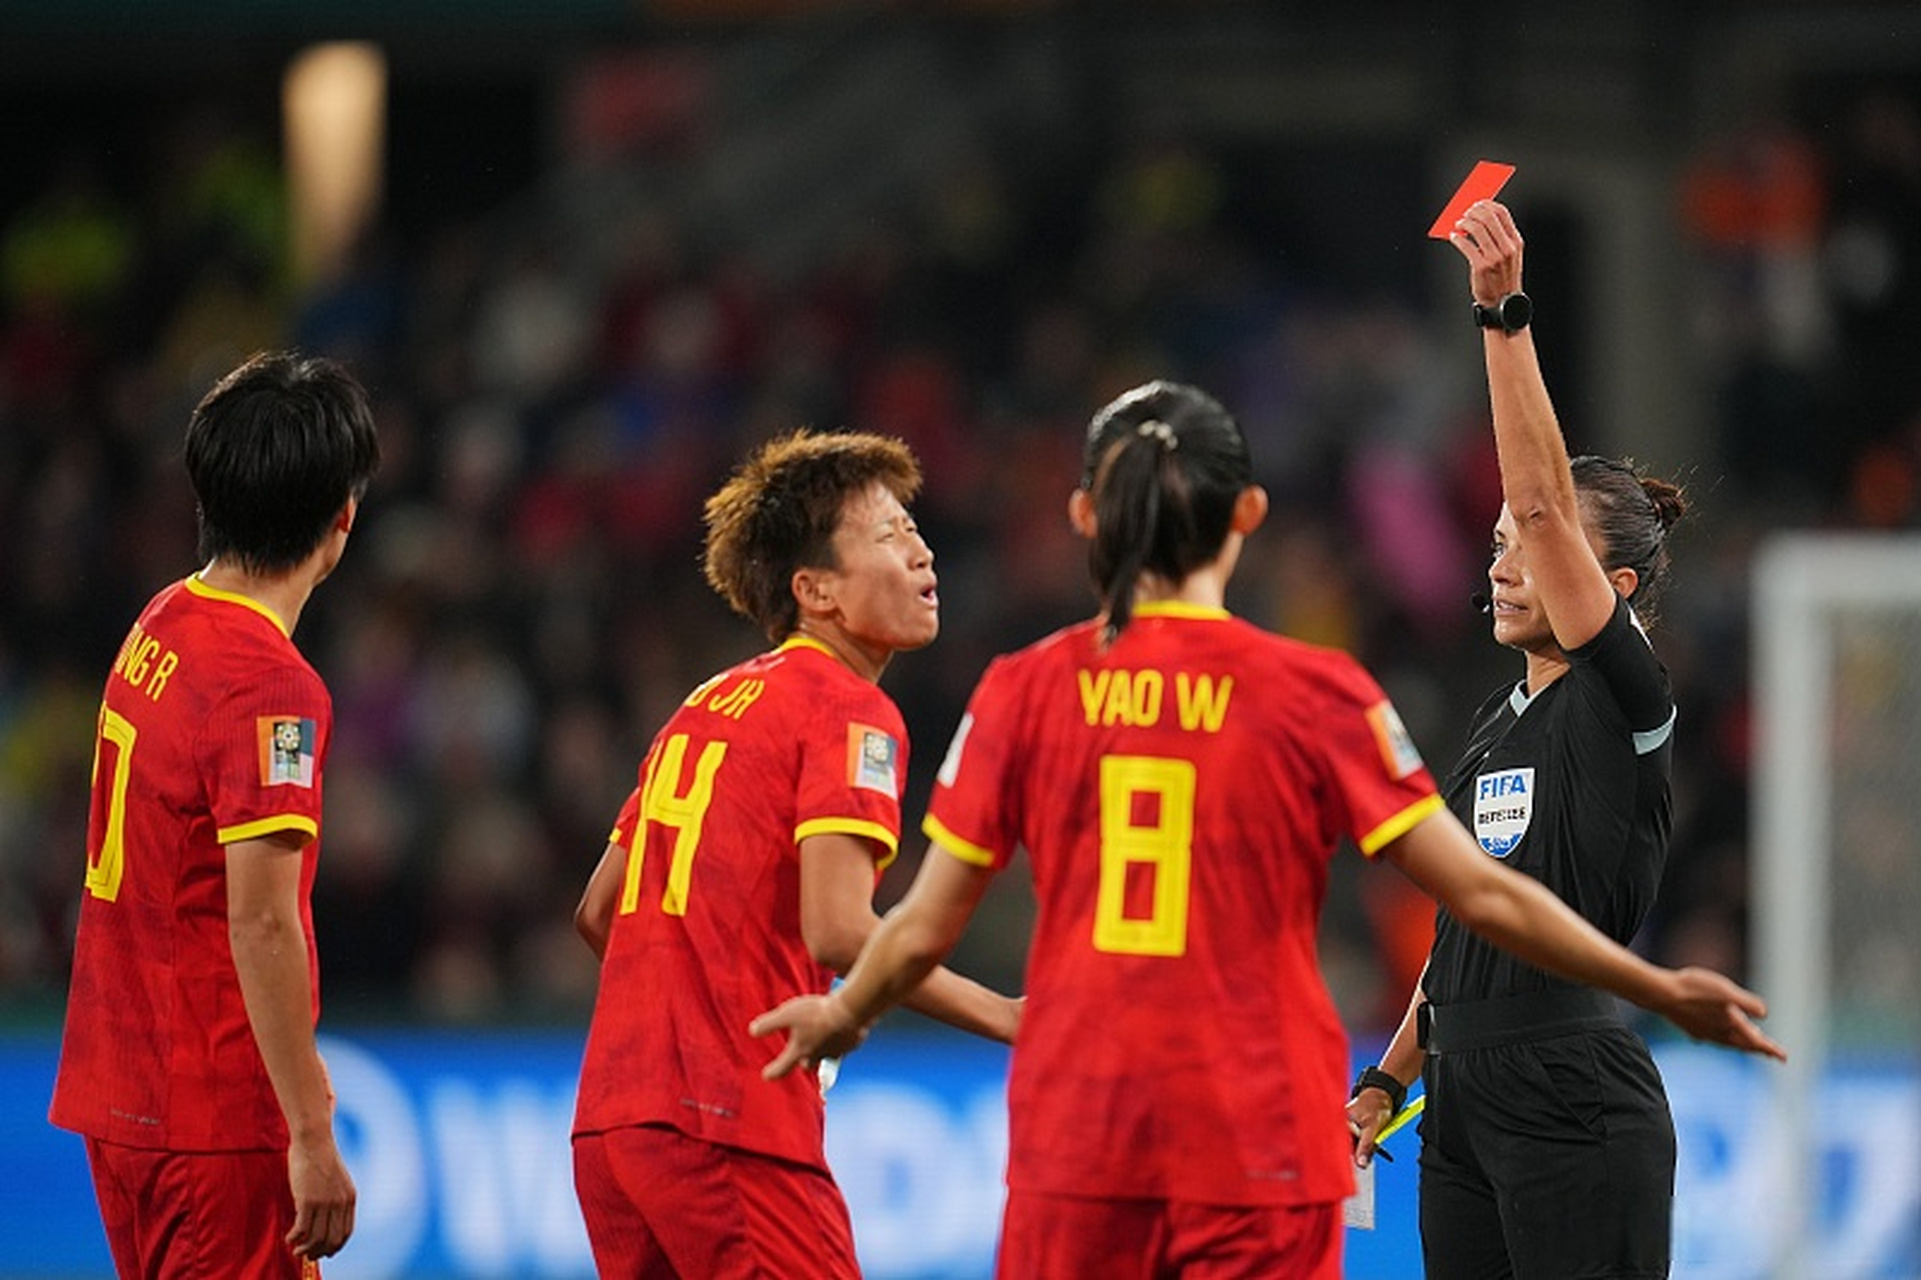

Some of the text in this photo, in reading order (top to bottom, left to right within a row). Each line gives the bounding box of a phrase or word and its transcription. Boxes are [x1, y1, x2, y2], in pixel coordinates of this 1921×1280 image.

[145, 650, 179, 701] R
[1078, 668, 1234, 733] YAO W
[1479, 774, 1527, 800] FIFA
[619, 733, 729, 917] 14
[1092, 754, 1197, 958] 8
